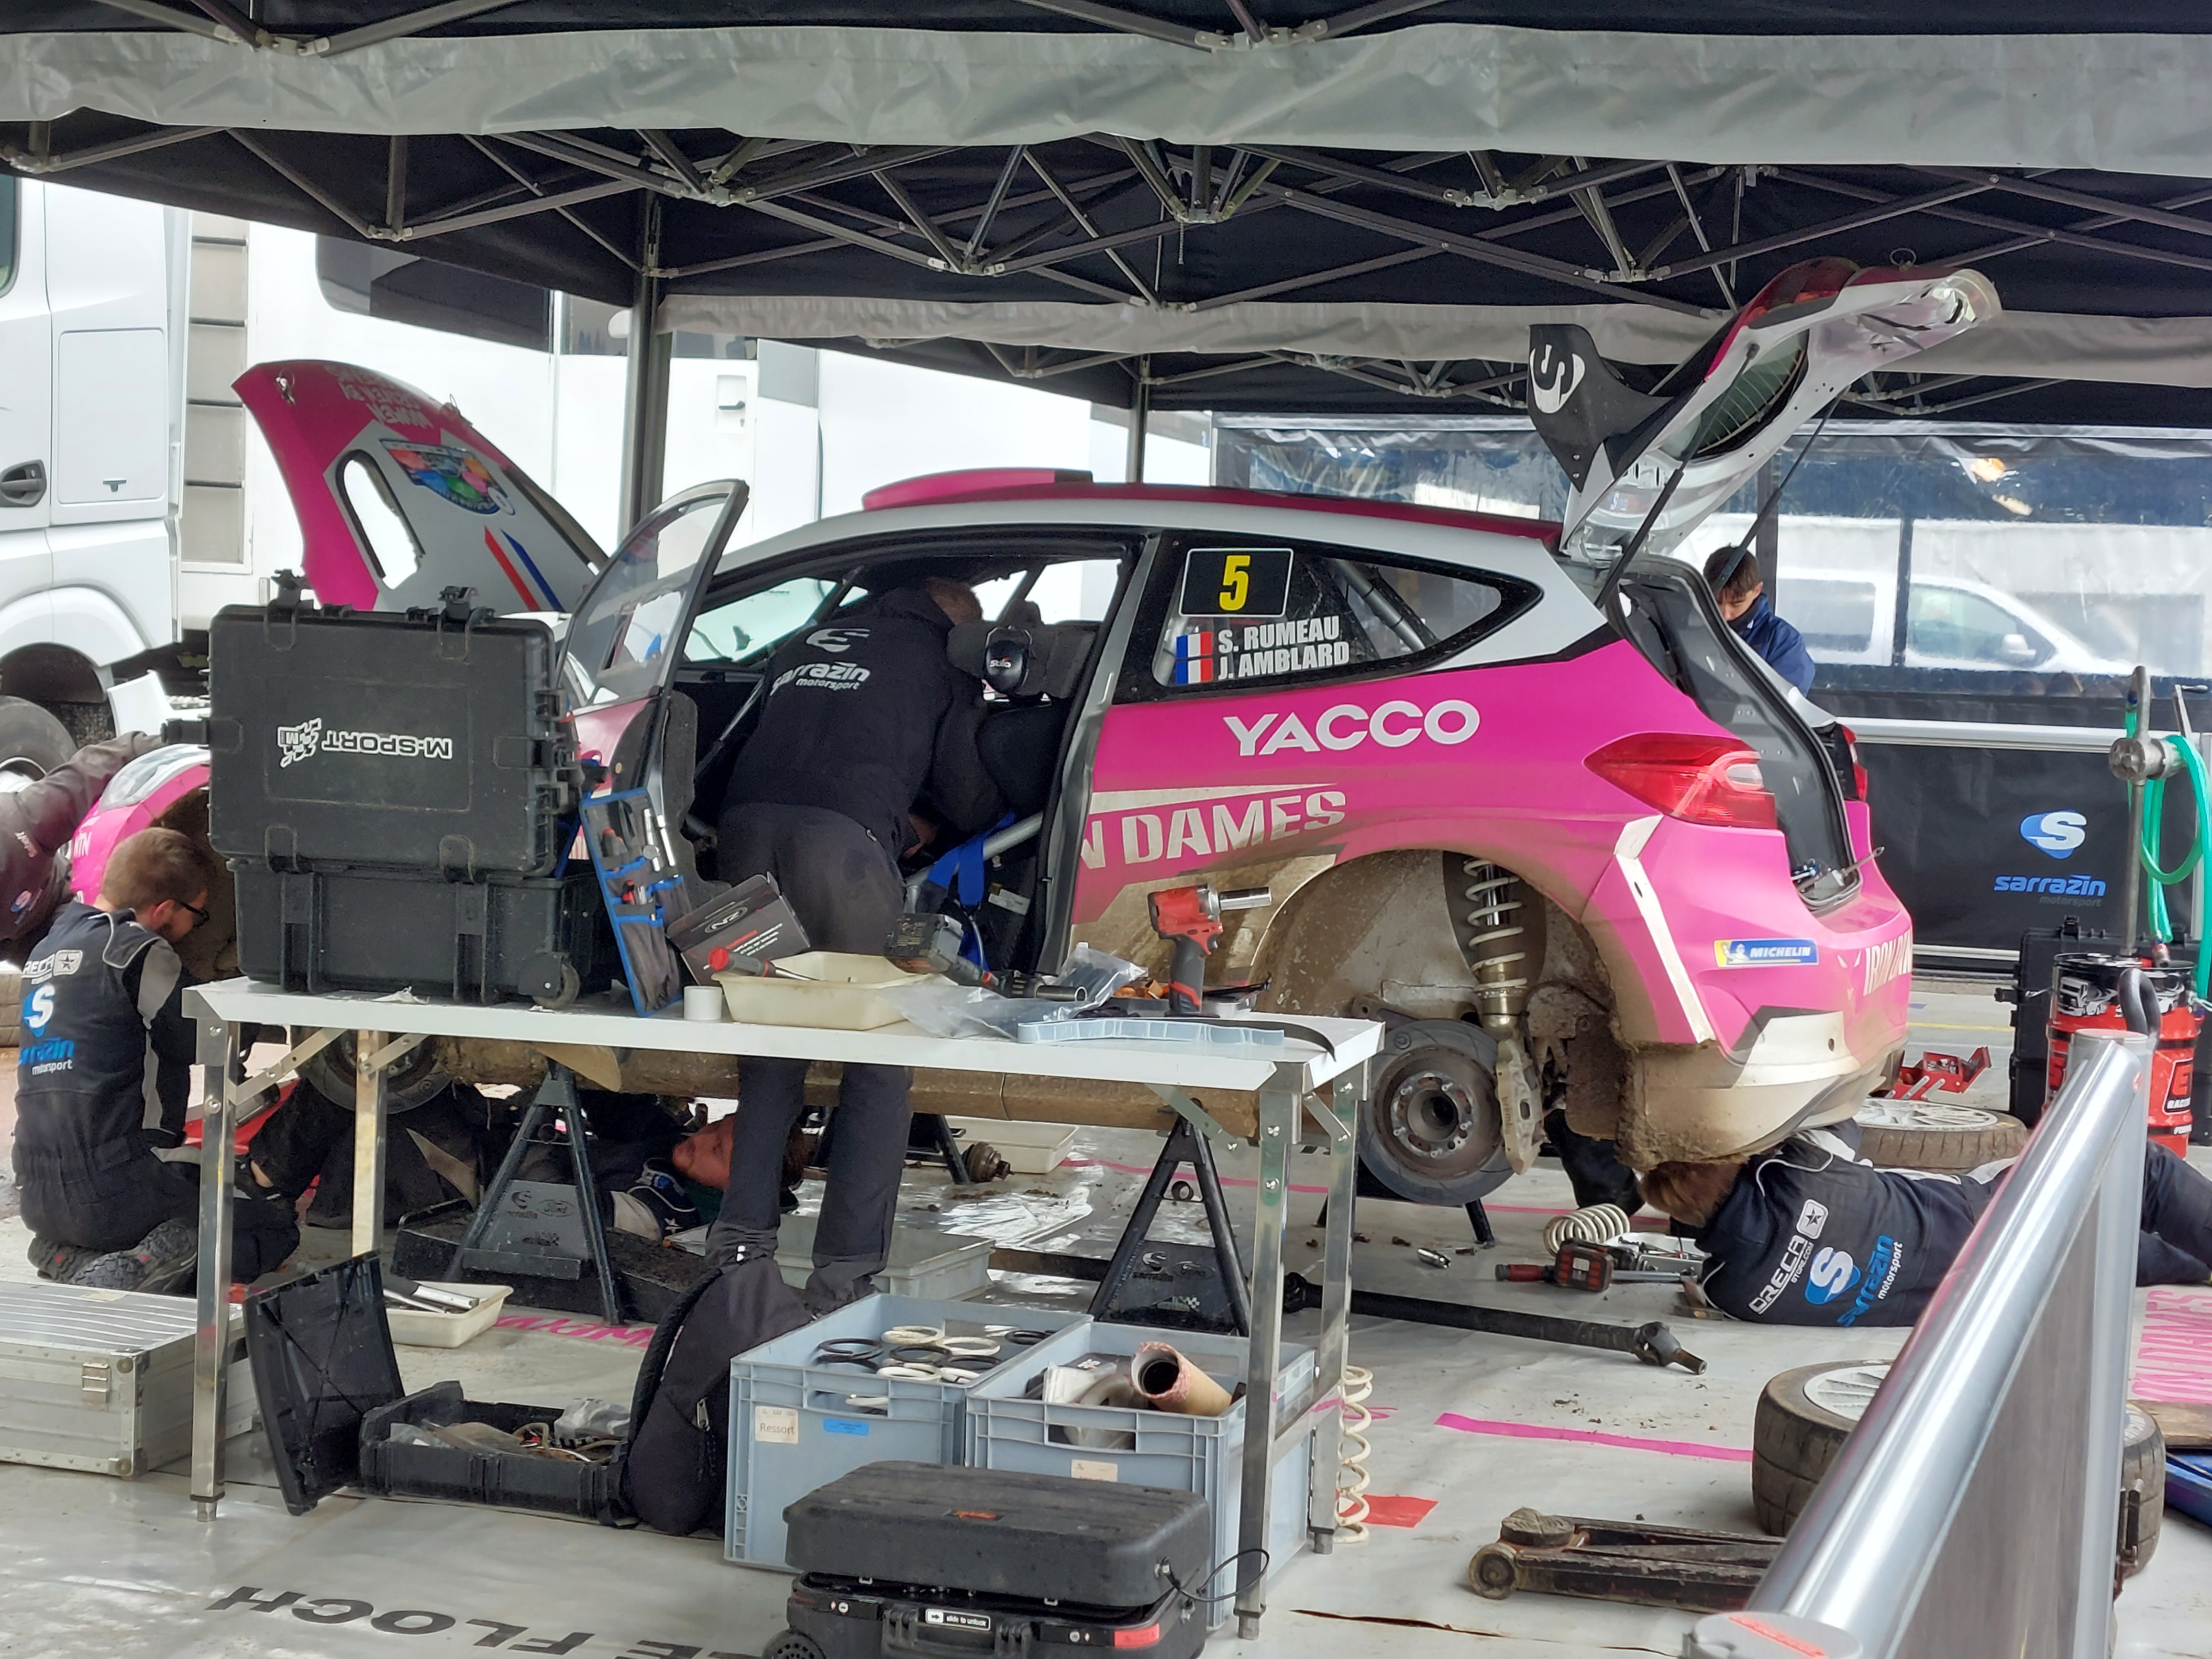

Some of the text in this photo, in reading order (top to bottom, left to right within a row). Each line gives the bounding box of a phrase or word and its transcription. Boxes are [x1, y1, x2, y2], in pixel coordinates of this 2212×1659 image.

[1219, 554, 1250, 610] 5
[1218, 616, 1340, 653] S. RUMEAU
[1219, 641, 1349, 680] J. AMBLARD
[796, 678, 860, 691] motorsport
[321, 730, 452, 760] M-SPORT
[1223, 699, 1480, 756] YACCO
[1122, 791, 1346, 864] DAMES
[1994, 874, 2106, 896] sarrazin
[2039, 896, 2102, 907] motorsport
[22, 953, 55, 976] RECA
[1750, 944, 1811, 959] MICHELIN
[1748, 1234, 1804, 1314] ORECA
[1877, 1241, 1903, 1300] motorsport
[760, 1423, 795, 1435] Ressort
[205, 1585, 596, 1656] FLOCH
